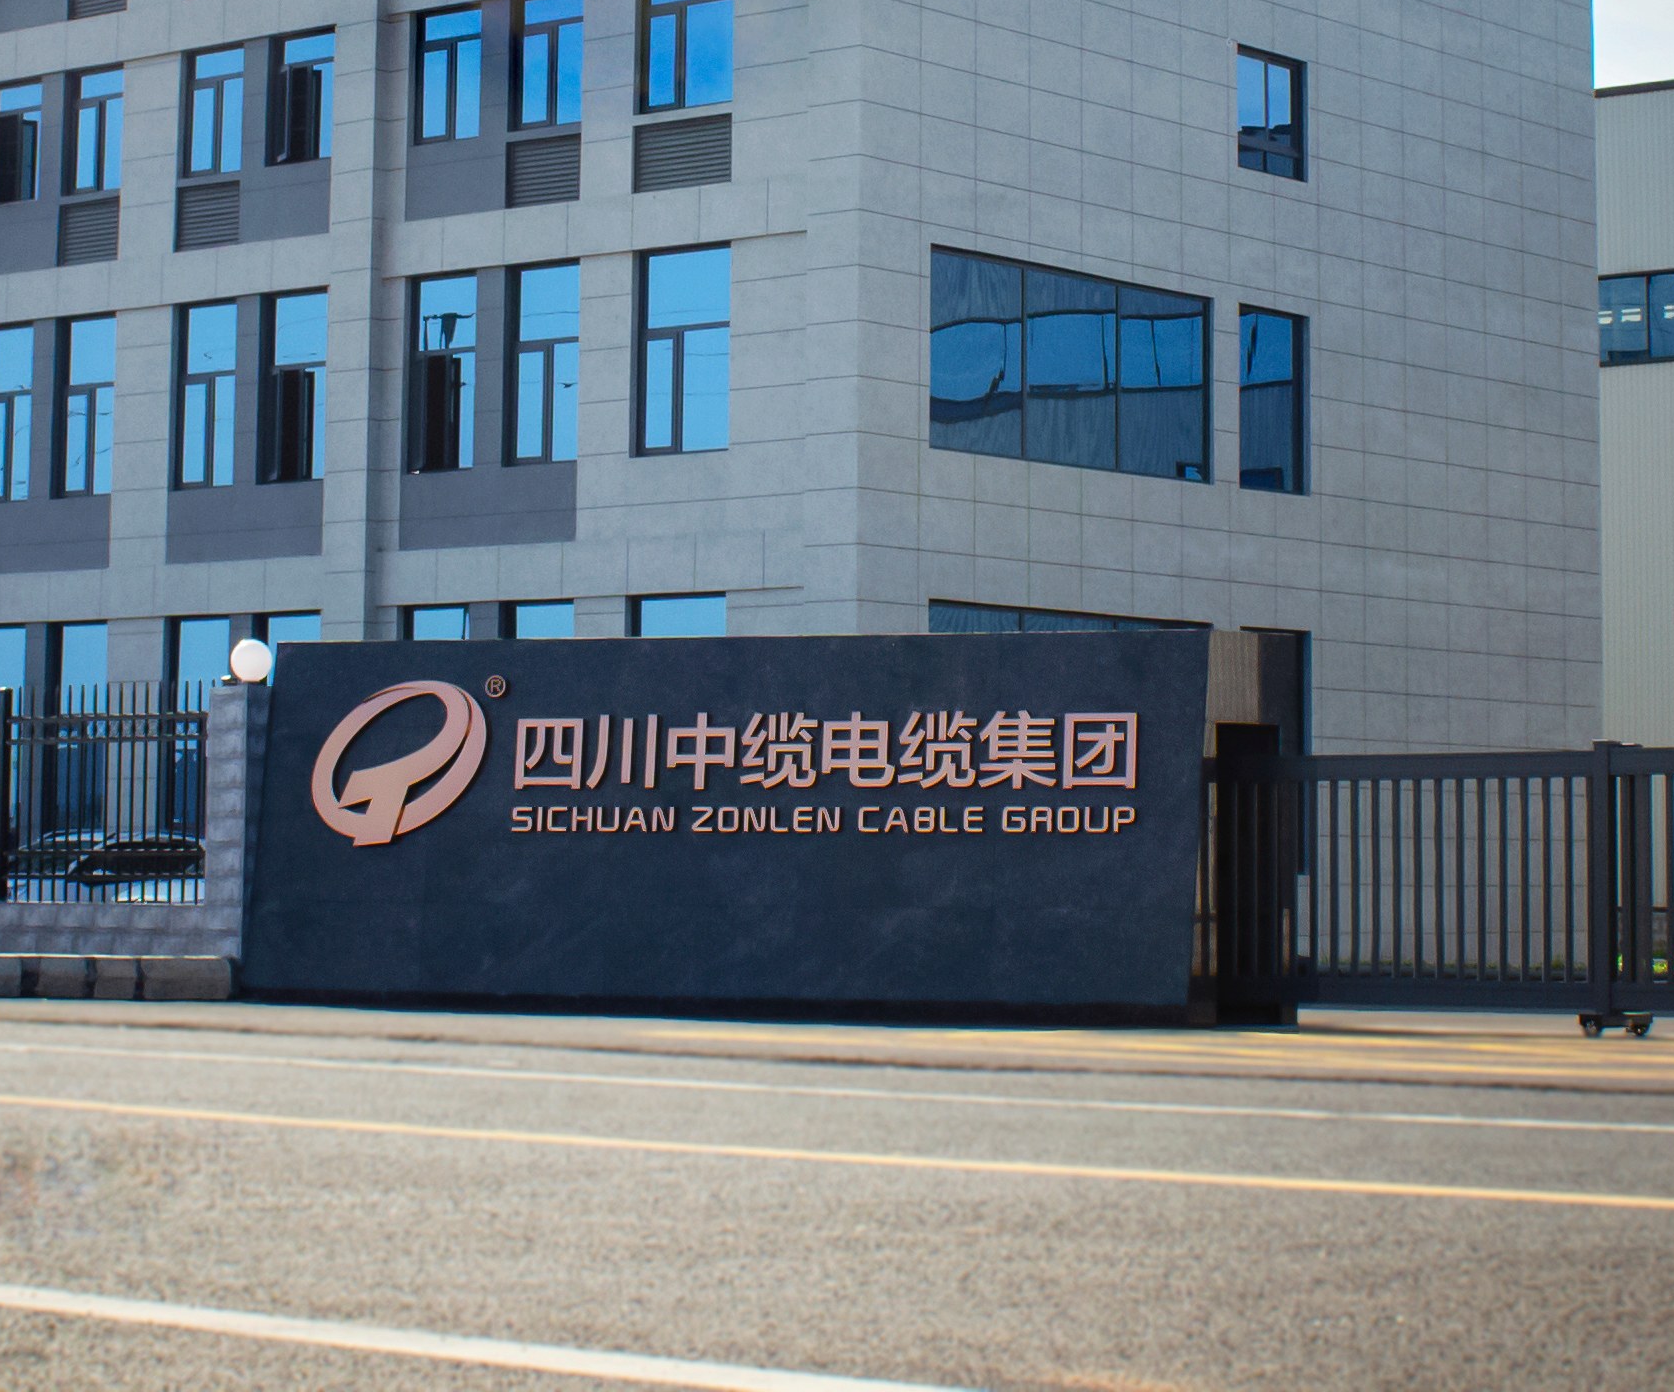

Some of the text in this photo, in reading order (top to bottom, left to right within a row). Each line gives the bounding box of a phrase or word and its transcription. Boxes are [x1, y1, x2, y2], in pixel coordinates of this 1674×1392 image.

[513, 711, 1138, 790] 四川中缆电缆集团
[511, 806, 1136, 834] SICHUAN ZONLEN CABLE GROUP
